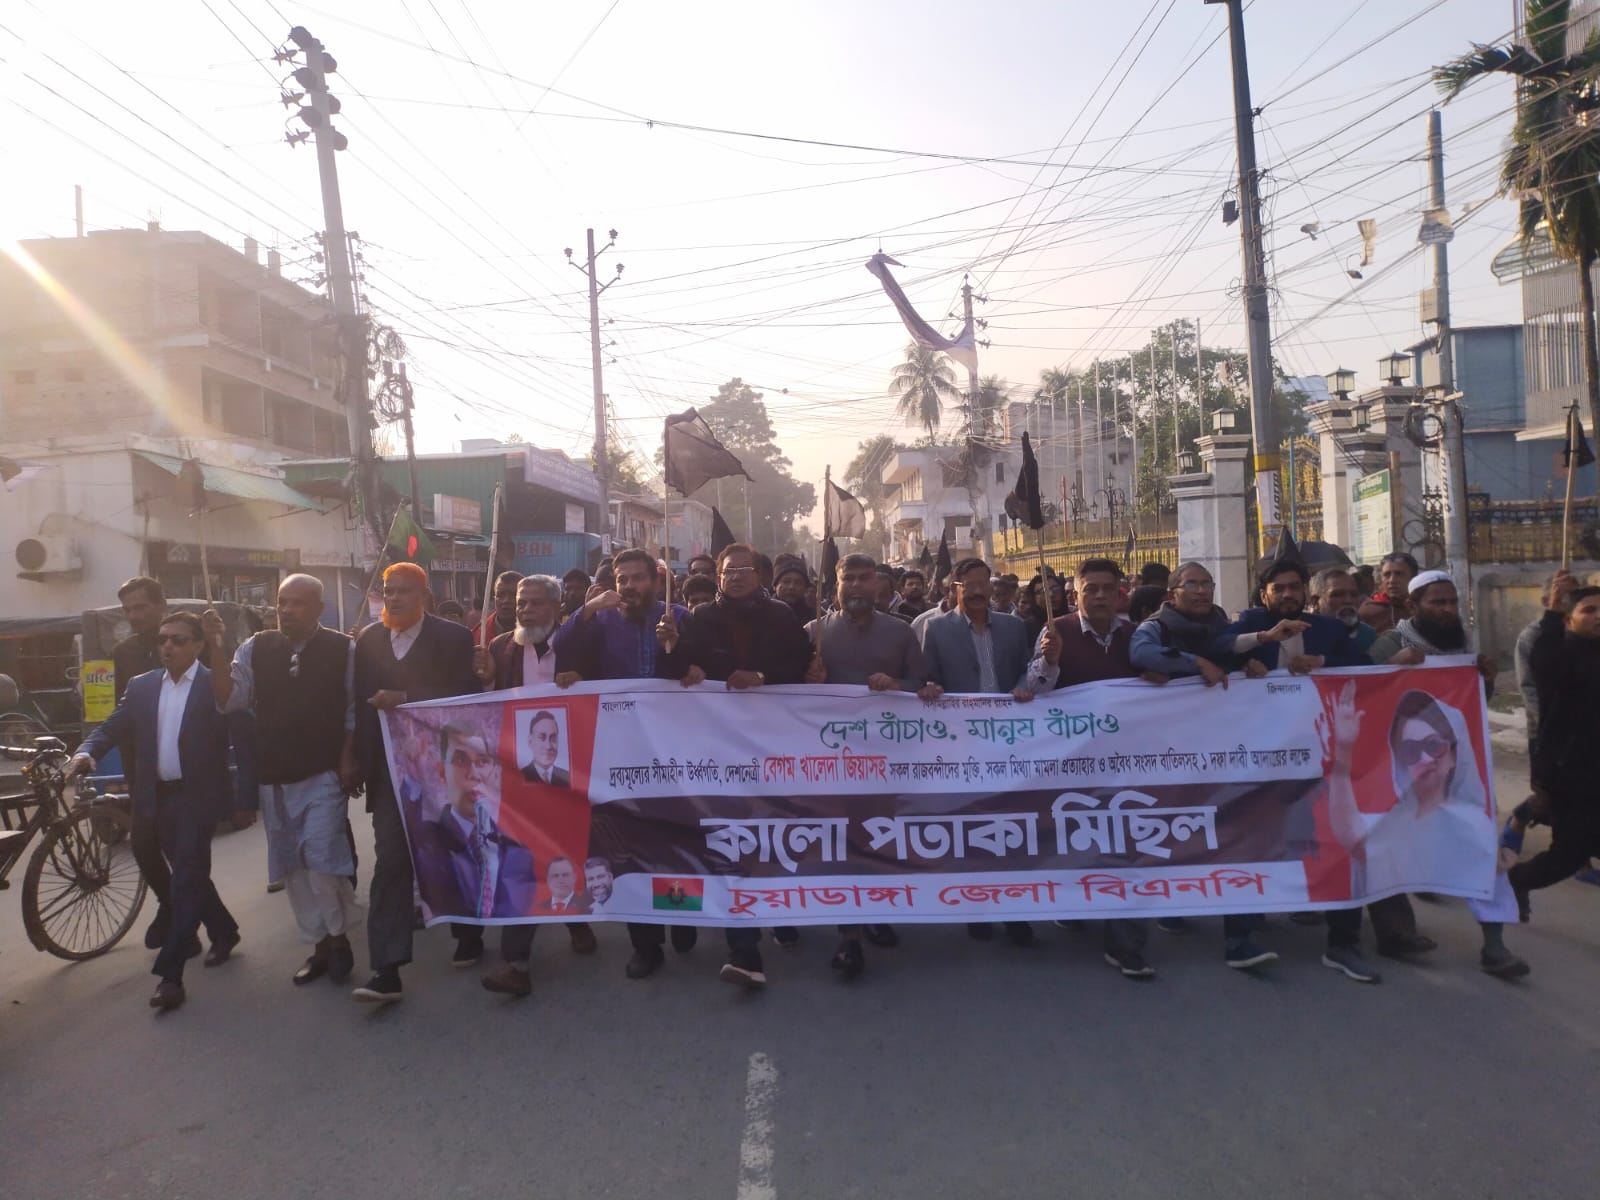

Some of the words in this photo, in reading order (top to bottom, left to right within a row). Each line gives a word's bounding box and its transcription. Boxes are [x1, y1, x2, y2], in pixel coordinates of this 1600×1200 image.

[601, 700, 636, 712] বাংলাদেশ
[820, 717, 868, 749] দেশ
[965, 715, 1035, 745] মানুষ
[1046, 707, 1120, 738] বাঁচাও
[651, 757, 684, 784] সীমাহীন
[725, 757, 760, 784] দেশনেত্রী
[763, 754, 796, 783] বেগম
[800, 752, 839, 782] খালেদা
[842, 745, 887, 783] জিয়াসহ
[889, 762, 910, 780] সকল
[985, 761, 1007, 780] সকল
[1009, 753, 1031, 779] মিথ্যা
[1033, 758, 1059, 778] মামলা
[1061, 756, 1096, 776] প্রত্যাহার
[1098, 758, 1106, 773] ও
[1107, 752, 1132, 774] অবৈধ
[1133, 754, 1158, 774] সংসদ
[1158, 746, 1200, 772] বাতিলসহ
[1208, 750, 1227, 772] দফা
[700, 817, 849, 873] কালো
[862, 812, 1039, 861] পতাকা
[1051, 790, 1218, 860] মিছিল
[727, 883, 919, 918] চুয়াডাঙ্গা
[938, 880, 1063, 906] জেলা
[1075, 869, 1271, 902] বিএনপি
